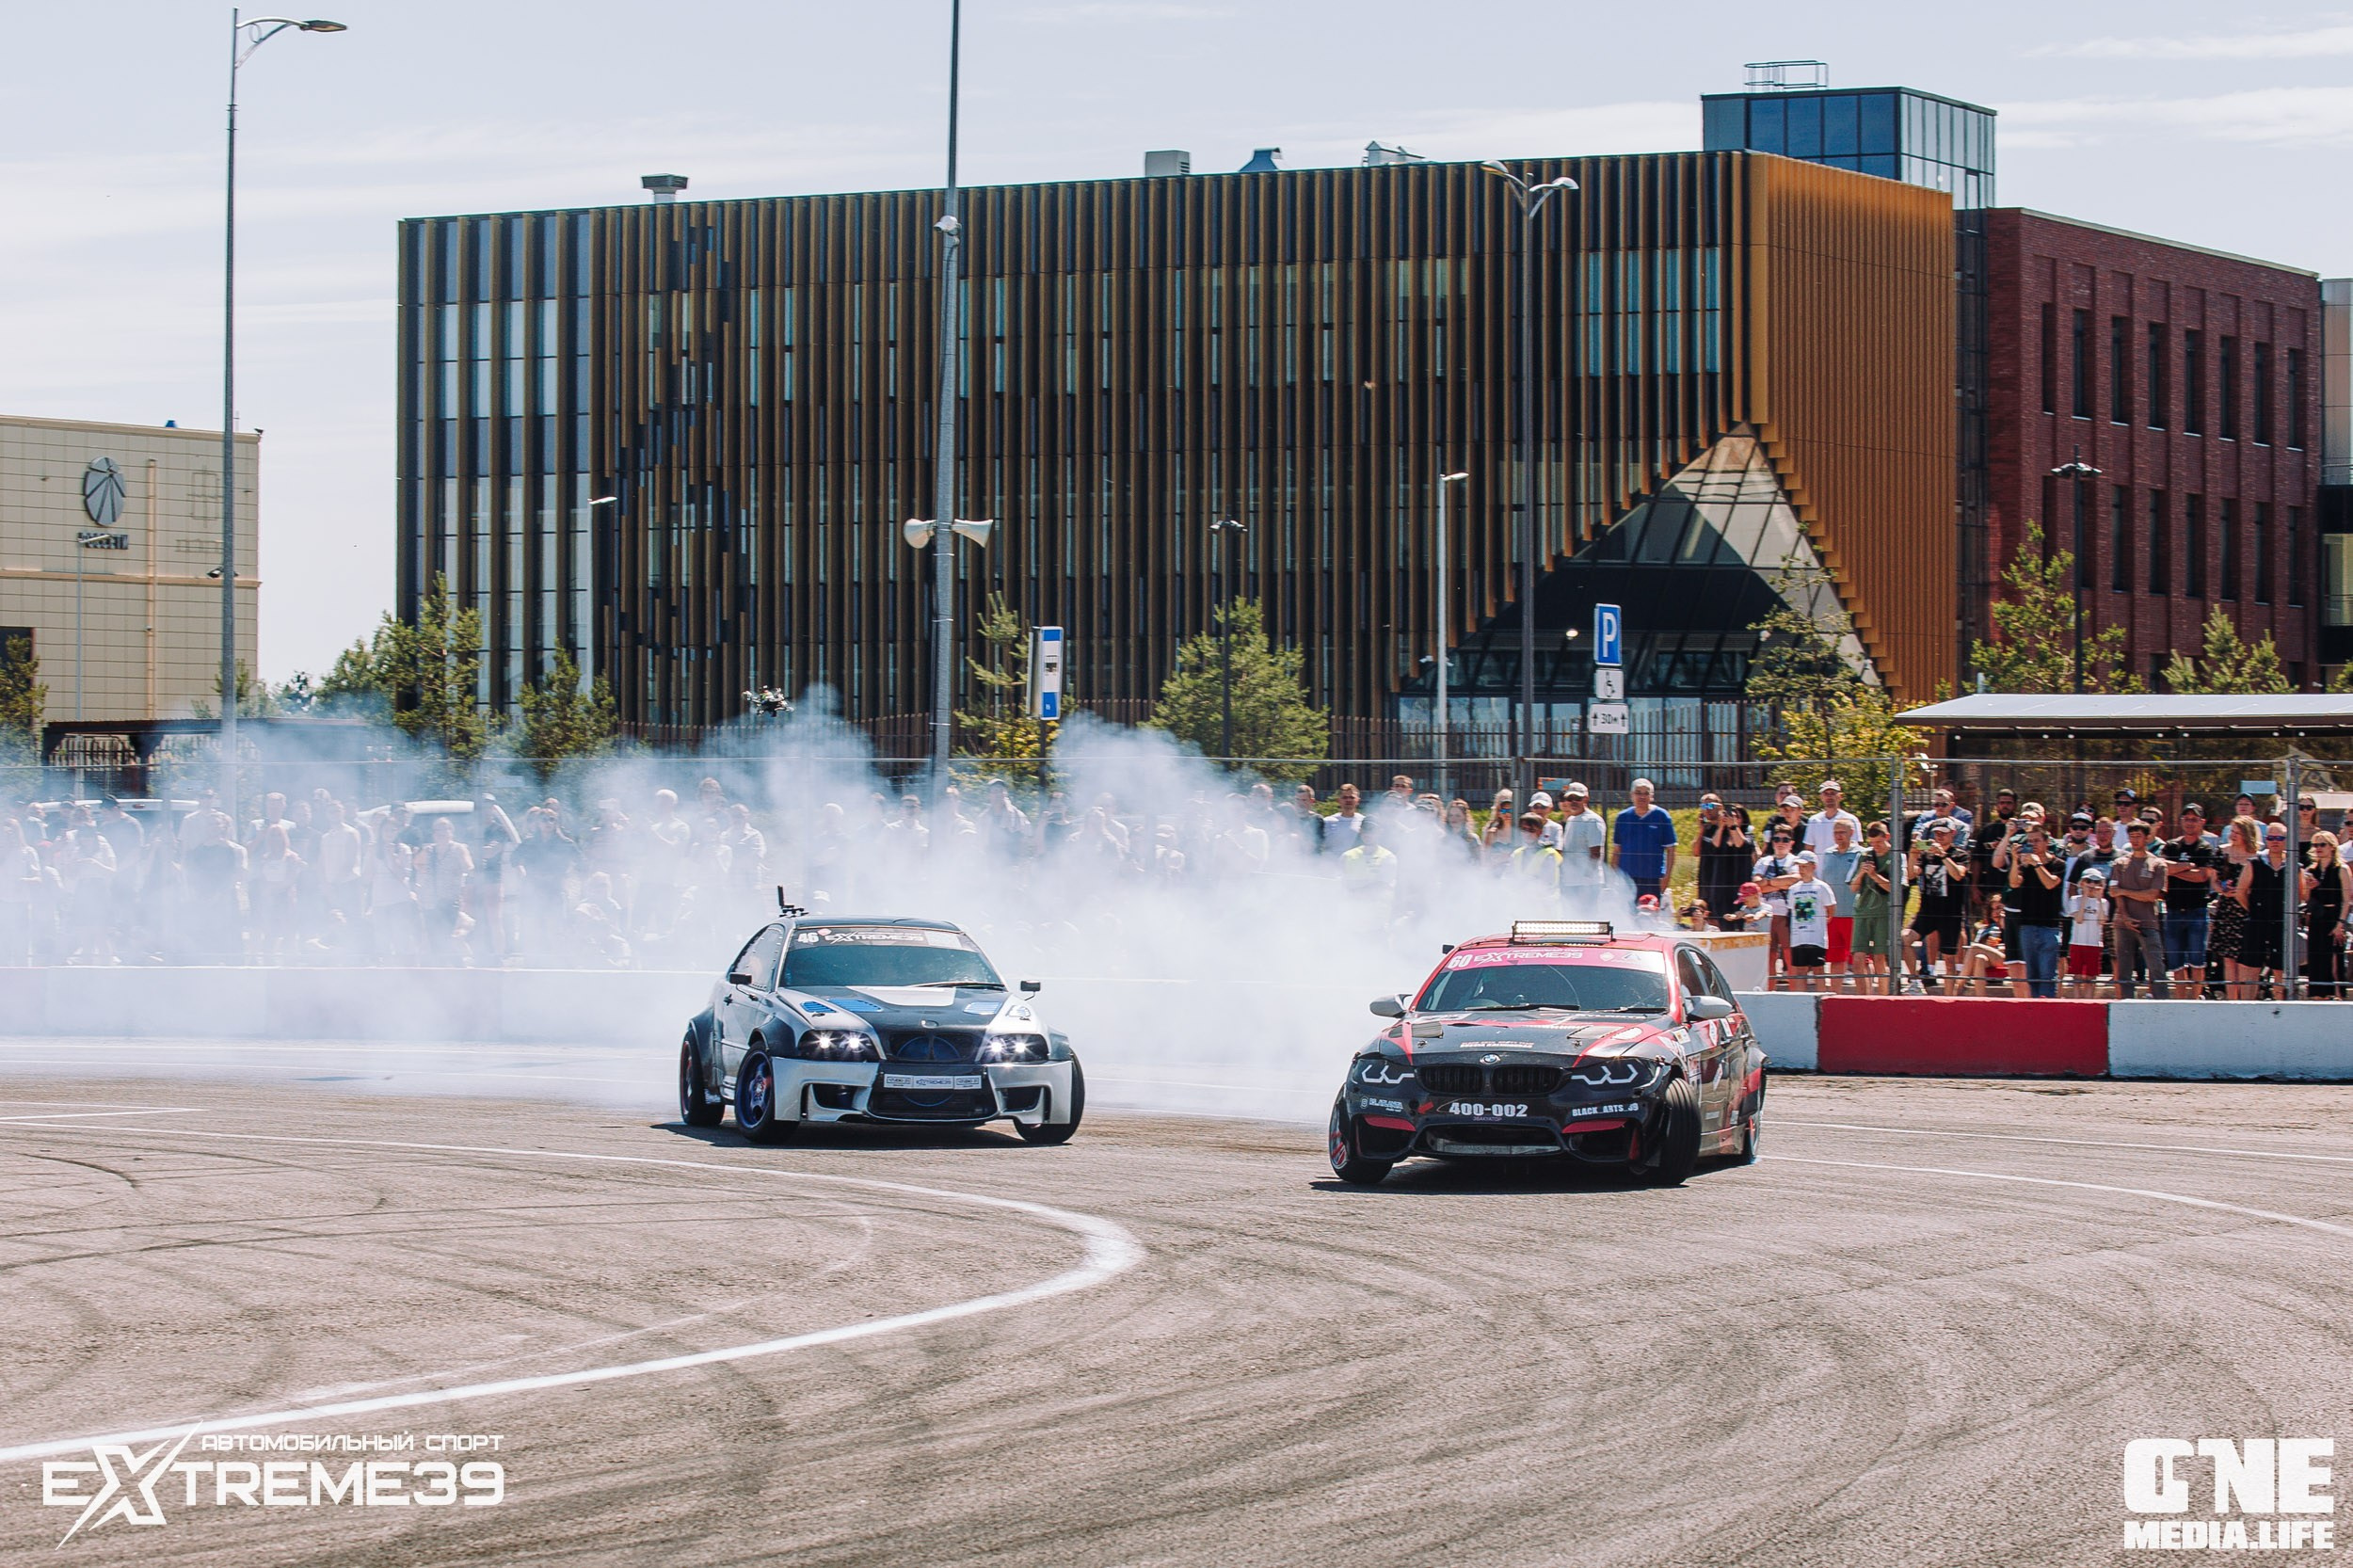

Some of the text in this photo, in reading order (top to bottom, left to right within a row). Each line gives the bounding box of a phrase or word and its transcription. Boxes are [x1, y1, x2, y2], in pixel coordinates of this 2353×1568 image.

[1602, 612, 1617, 658] P
[797, 932, 820, 945] 46
[1447, 949, 1583, 968] 60 EXTREME39
[1449, 1102, 1529, 1117] 400-002
